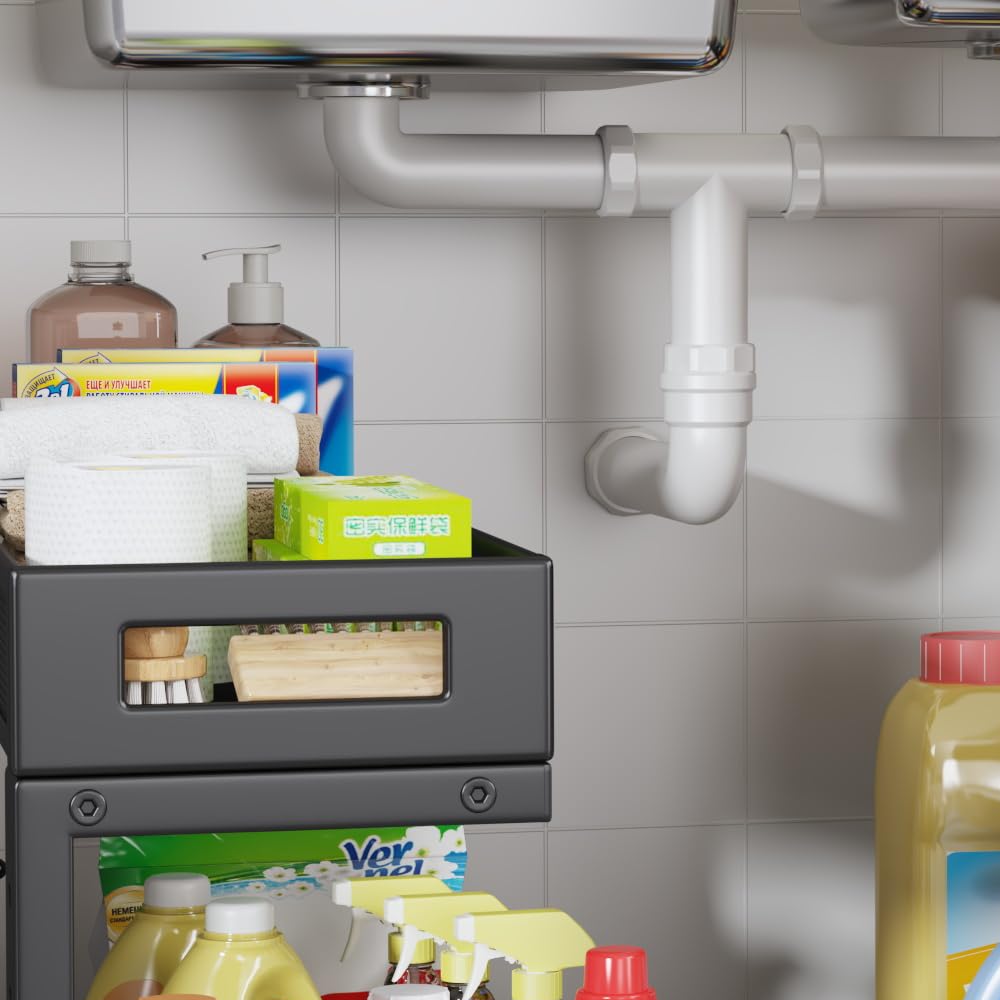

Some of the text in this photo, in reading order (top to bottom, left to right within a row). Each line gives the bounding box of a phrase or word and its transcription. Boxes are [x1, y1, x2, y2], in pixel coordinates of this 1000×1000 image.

[86, 380, 151, 390] ЕЩЕ И УЛУЧШАЕТ
[343, 838, 414, 870] Ver
